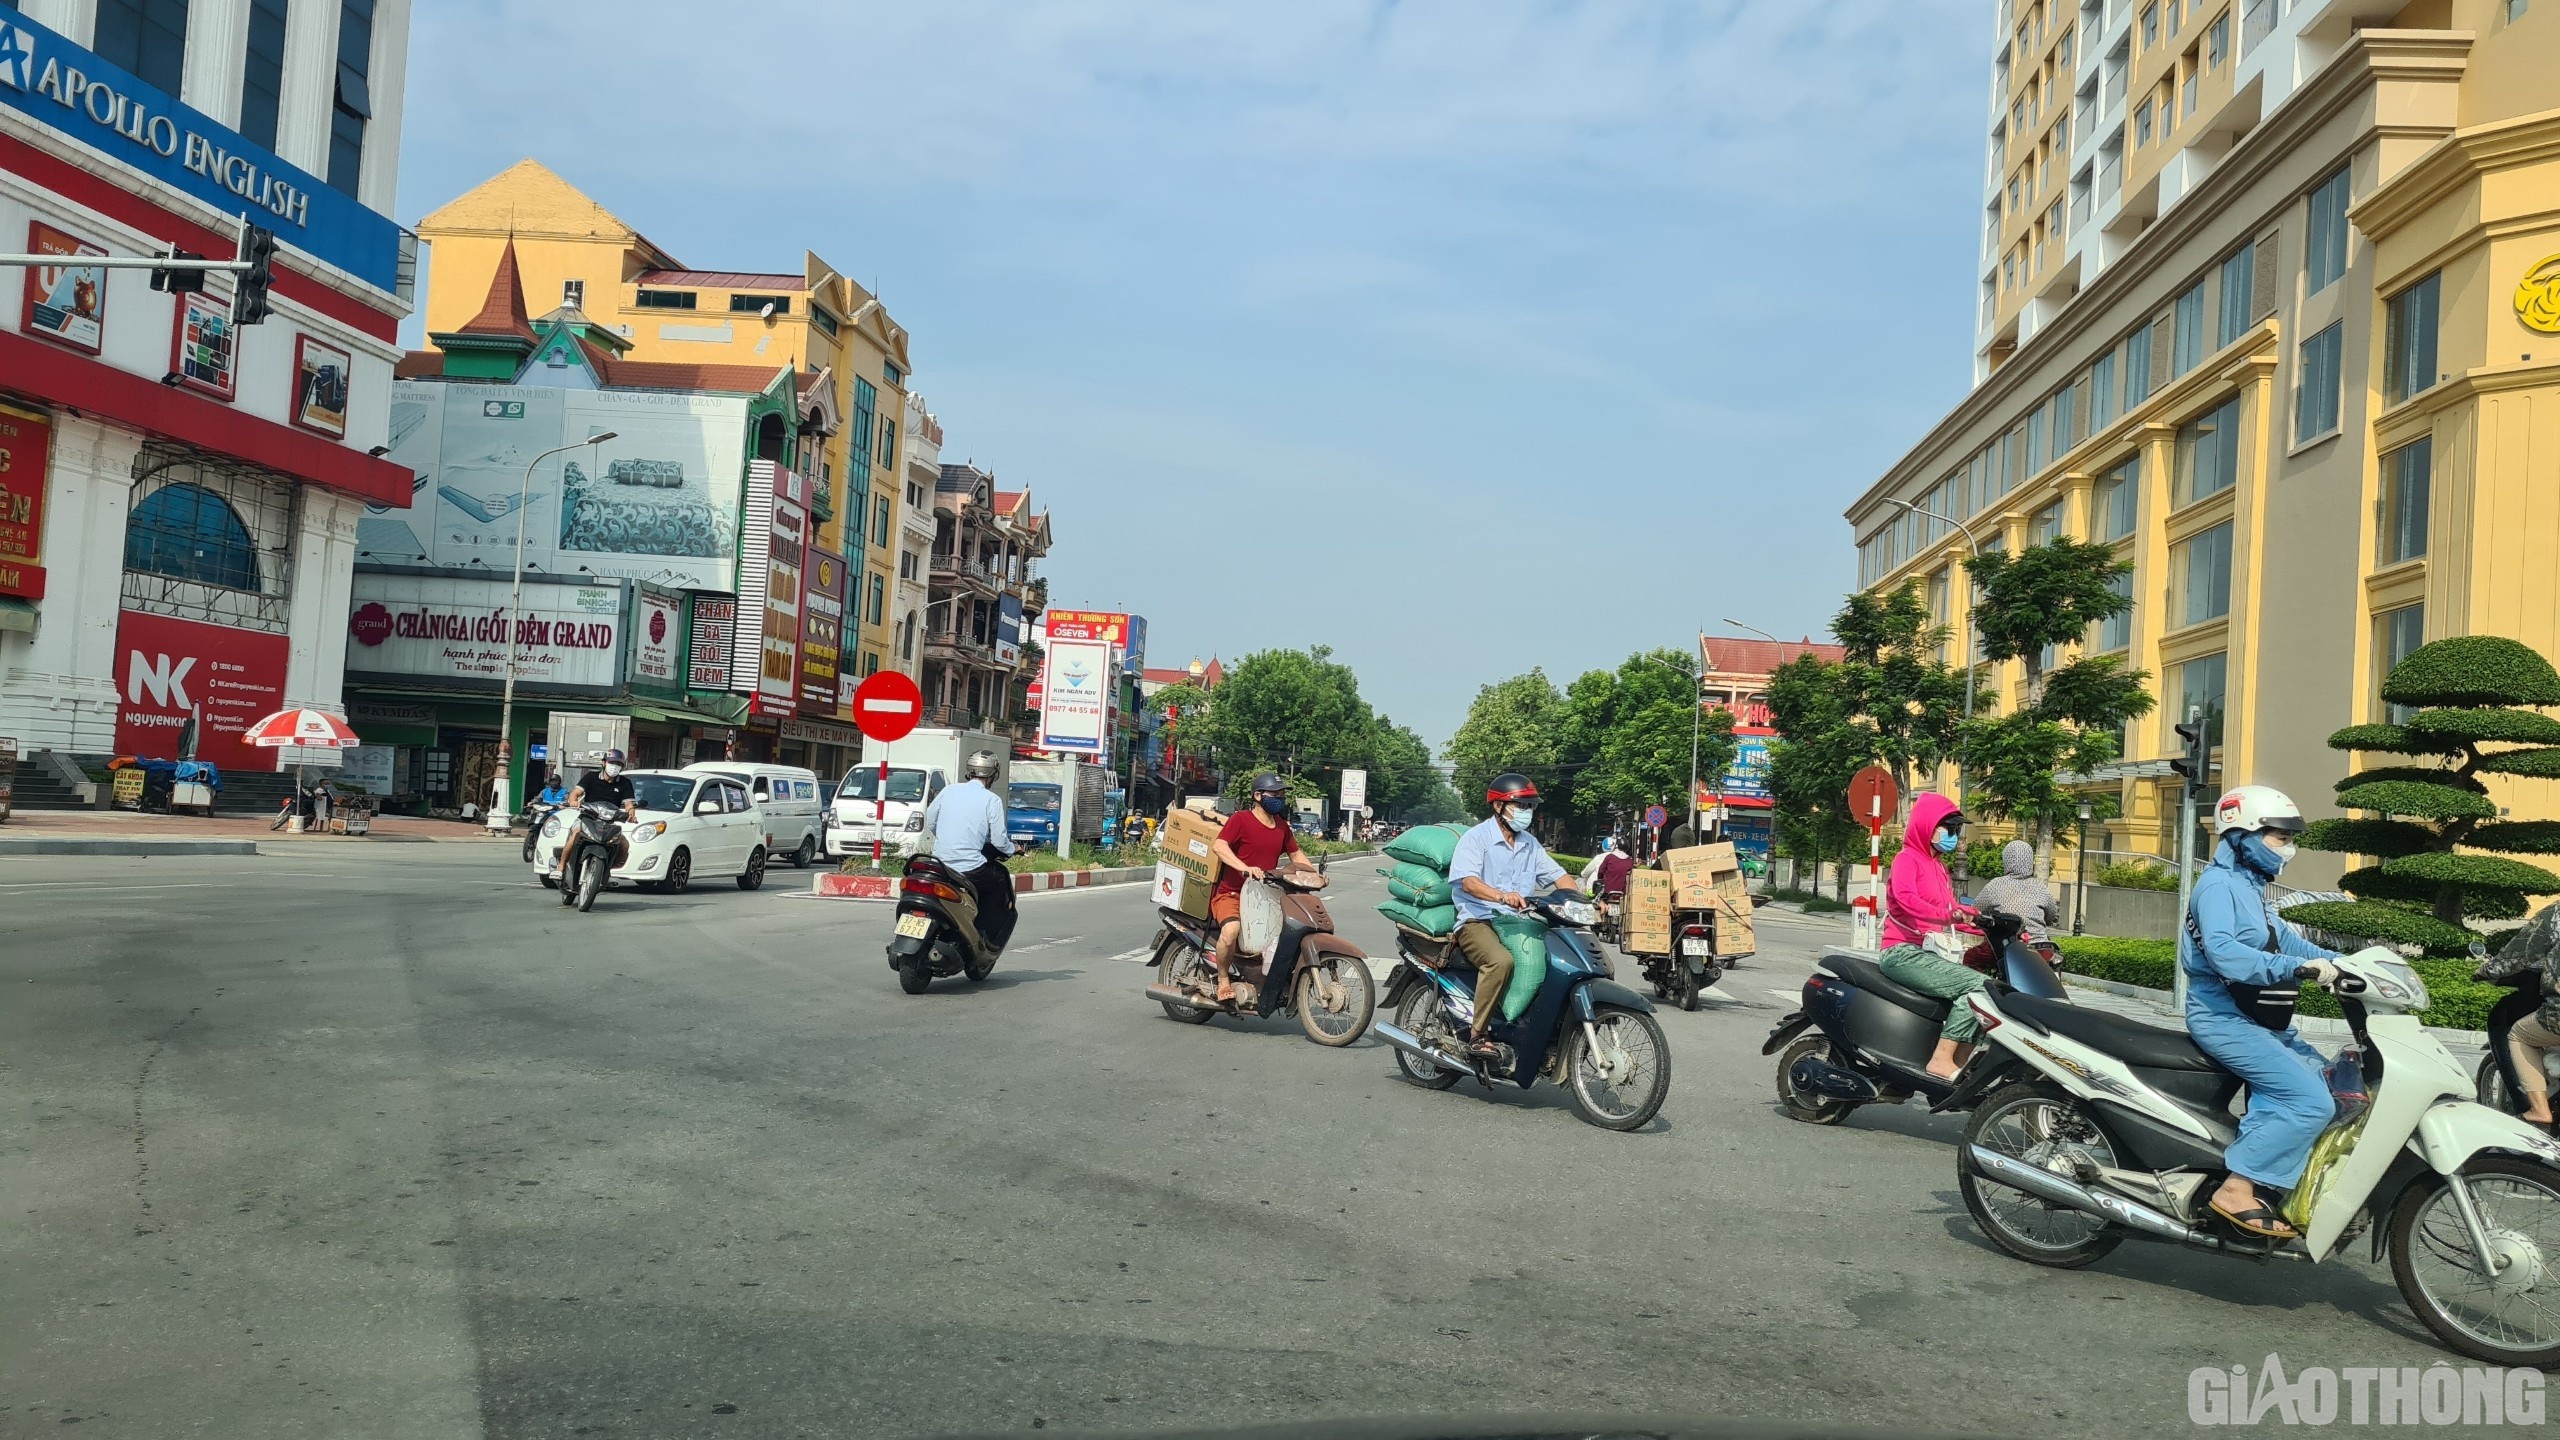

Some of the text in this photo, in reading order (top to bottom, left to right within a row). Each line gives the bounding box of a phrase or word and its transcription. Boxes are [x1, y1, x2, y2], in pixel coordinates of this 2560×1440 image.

[36, 57, 310, 228] APOLLO ENGLISH
[577, 589, 608, 599] THANH
[576, 599, 617, 607] BINHOME
[358, 618, 388, 630] grand
[396, 607, 442, 640] CHĂN
[446, 614, 468, 642] GA
[476, 607, 507, 644] GỐI
[553, 621, 612, 649] GRAND
[703, 624, 720, 640] GA
[443, 647, 475, 660] hạnh
[477, 647, 507, 661] phúc
[455, 662, 549, 676] The simple appiness
[1078, 706, 1088, 714] 55
[819, 728, 830, 740] XE
[832, 727, 848, 742] MÁY
[1161, 846, 1208, 876] HUYHOANG
[1858, 912, 1866, 920] H2
[899, 923, 922, 936] 6724
